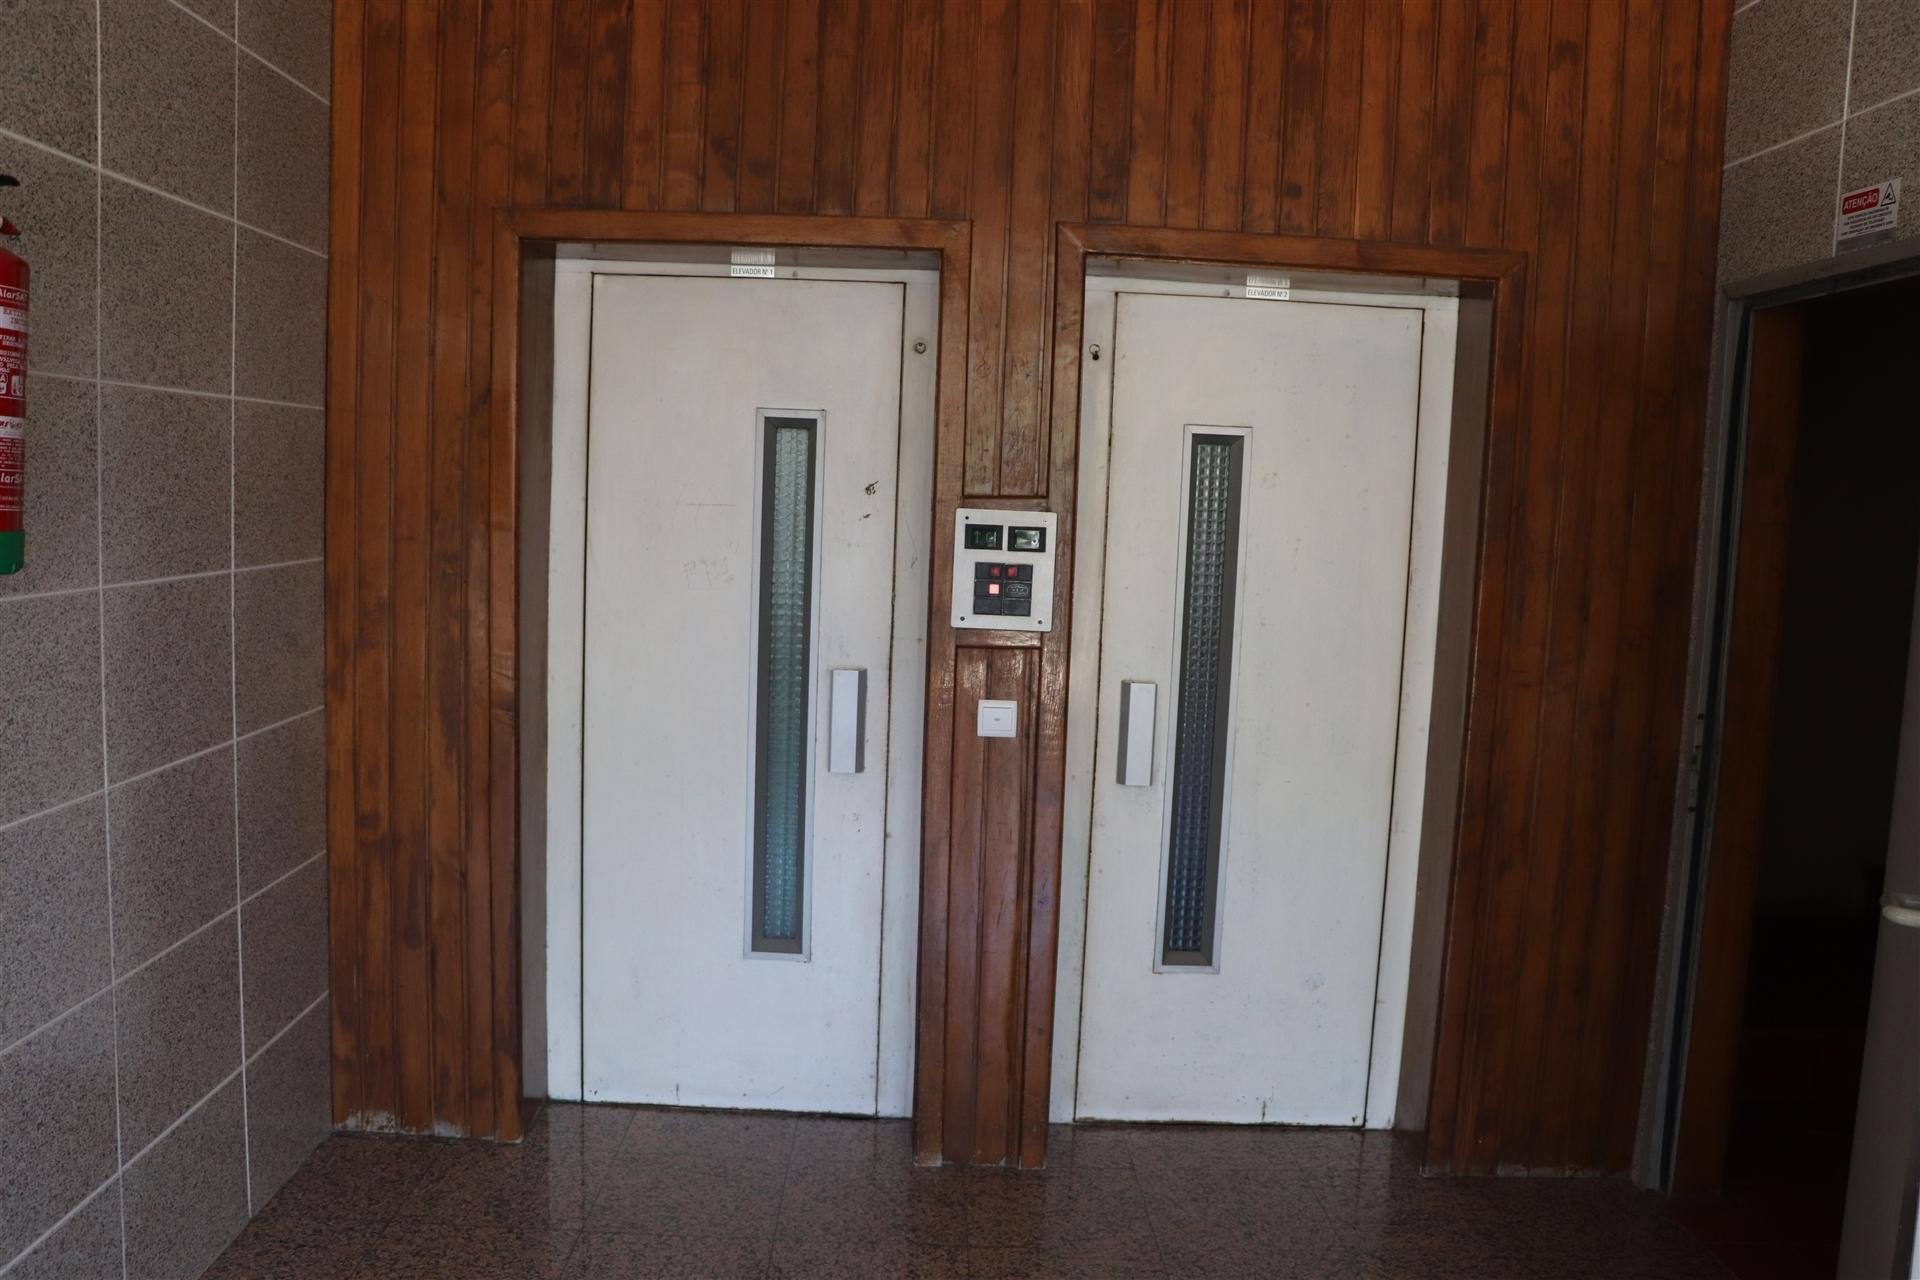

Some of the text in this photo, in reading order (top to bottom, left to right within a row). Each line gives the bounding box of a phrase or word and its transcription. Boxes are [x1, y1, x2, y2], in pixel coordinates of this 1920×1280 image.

[1844, 192, 1878, 209] ATENÇÃO
[733, 267, 761, 275] ELEVADOR
[1248, 288, 1276, 297] ELEVADOR
